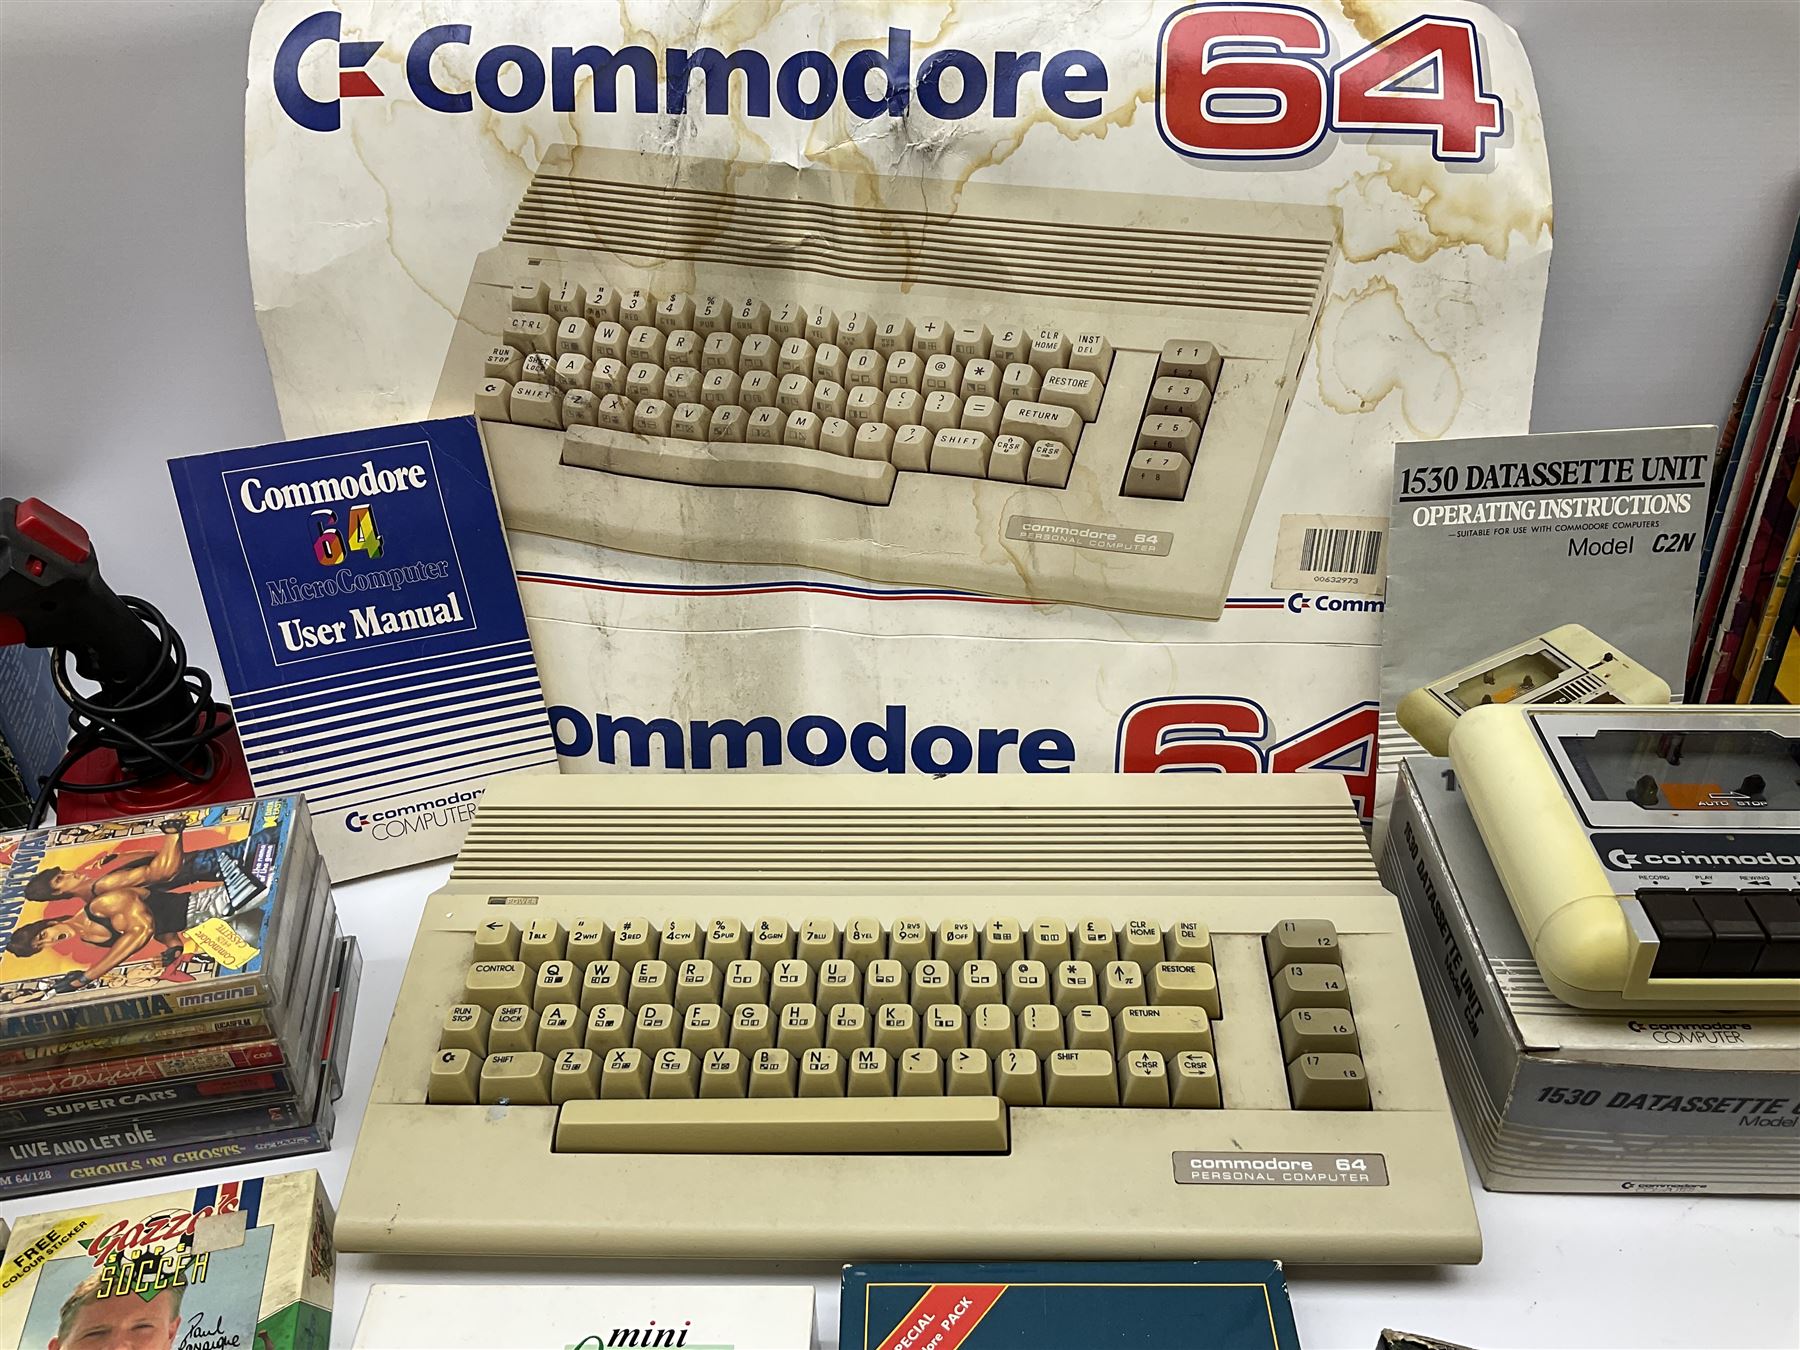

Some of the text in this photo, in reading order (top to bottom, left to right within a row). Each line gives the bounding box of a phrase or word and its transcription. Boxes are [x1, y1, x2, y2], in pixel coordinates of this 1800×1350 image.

[406, 2, 1505, 163] Commodore 64
[512, 318, 541, 329] CTRL
[1041, 330, 1059, 340] CLR
[1078, 335, 1100, 344] INST
[1035, 341, 1058, 350] HOME
[492, 348, 510, 356] RUN
[487, 355, 510, 363] STOP
[1049, 376, 1089, 389] RESTORE
[517, 387, 551, 398] SHIFT
[1019, 409, 1059, 421] RETURN
[940, 435, 978, 445] SHIFT
[1401, 455, 1707, 494] 1530 DATASSETTE UNIT
[240, 460, 428, 514] Commodore
[1412, 493, 1691, 527] OPERATING INSTRUCTIONS
[1494, 526, 1510, 535] FOR
[1513, 525, 1527, 534] USE
[1531, 524, 1552, 533] WITH
[1555, 521, 1609, 532] COMMODORE
[1612, 520, 1660, 530] COMPUTERS
[308, 503, 386, 566] 64
[1022, 523, 1158, 544] commodore 64
[1020, 532, 1156, 552] PERSONAL COMPUTER
[1568, 532, 1696, 556] Model C2N
[266, 559, 449, 607] MicroComputer
[1313, 576, 1358, 584] 00632973
[278, 591, 464, 652] User Manual
[547, 705, 1076, 773] ommodore
[372, 788, 487, 822] commodor
[372, 802, 478, 841] COMPUTER
[1416, 859, 1463, 971] DATASSETTE
[1459, 967, 1486, 1020] UNIT
[476, 964, 515, 972] CONTROL
[547, 965, 560, 976] Q
[594, 964, 609, 975] W
[640, 964, 648, 975] E
[687, 964, 696, 975] R
[734, 964, 742, 975] T
[781, 963, 790, 974] Y
[828, 964, 837, 975] U
[923, 964, 935, 975] O
[971, 964, 979, 975] P
[1161, 965, 1196, 973] RESTORE
[454, 1007, 472, 1015] RUN
[501, 1007, 522, 1015] SHIFT
[550, 1008, 561, 1018] A
[597, 1008, 606, 1018] S
[645, 1008, 656, 1018] D
[693, 1008, 700, 1018] F
[742, 1007, 754, 1018] G
[790, 1007, 799, 1017] H
[838, 1007, 845, 1018] J
[887, 1008, 895, 1018] K
[935, 1008, 941, 1019] L
[1129, 1009, 1160, 1017] RETURN
[1649, 1021, 1752, 1031] commodore
[1652, 1031, 1745, 1044] COMPUTER
[563, 1051, 574, 1062] Z
[613, 1051, 626, 1062] X
[663, 1051, 676, 1062] C
[713, 1051, 724, 1062] V
[760, 1051, 769, 1062] B
[810, 1051, 821, 1062] N
[859, 1051, 873, 1062] M
[1135, 1061, 1158, 1069] CRSR
[1184, 1061, 1207, 1069] CRSR
[44, 1089, 177, 1117] SUPER CARS
[1536, 1086, 1601, 1107] 1530
[1606, 1092, 1790, 1115] DATASSETTE
[10, 1119, 157, 1160] LIVE AND LET DIE
[15, 1170, 52, 1184] 64/128
[70, 1159, 142, 1180] GHOULS
[172, 1143, 241, 1164] GHOSTS
[1190, 1157, 1367, 1172] commodore 64
[1191, 1171, 1369, 1183] PERSONAL COMPUTER
[13, 1229, 61, 1268] FREE
[108, 1242, 187, 1264] SUPE
[2, 1220, 88, 1289] COLOUR STICKER
[96, 1251, 211, 1299] SOCCER
[940, 1295, 973, 1332] PACK
[606, 1320, 691, 1348] mini
[893, 1312, 936, 1350] PECIAL
